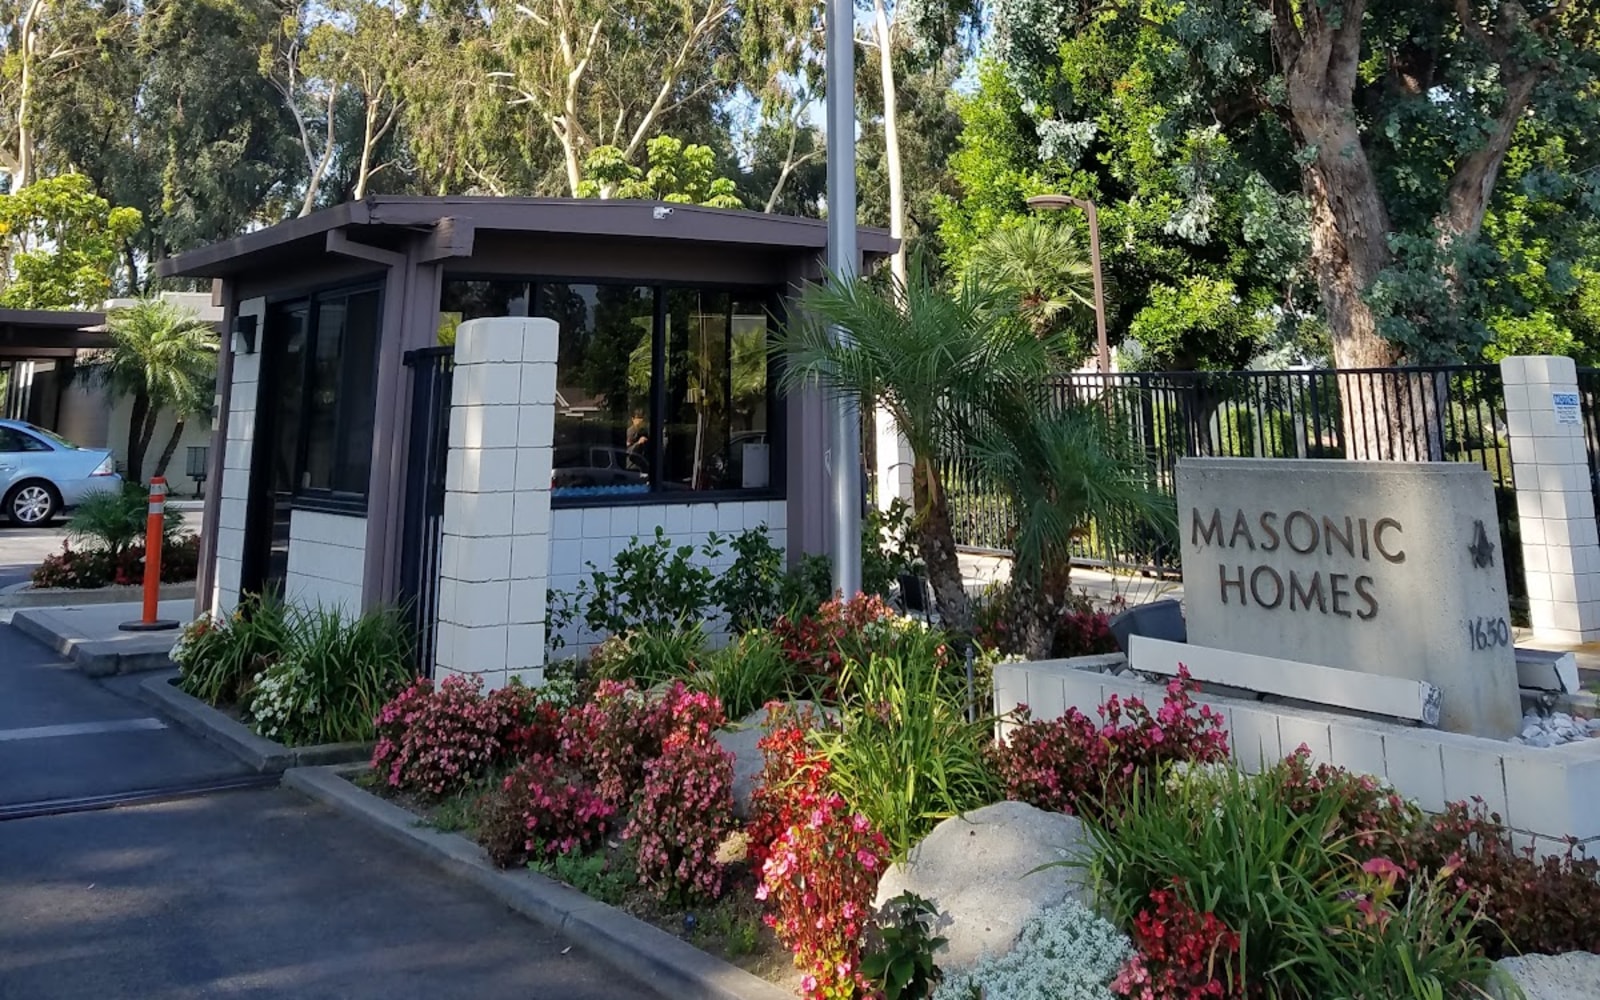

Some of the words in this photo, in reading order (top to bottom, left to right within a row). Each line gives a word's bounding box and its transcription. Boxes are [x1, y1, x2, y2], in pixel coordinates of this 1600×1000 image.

[1192, 507, 1406, 564] MASONIC
[1219, 564, 1379, 620] HOMES
[1469, 616, 1508, 652] 1650
